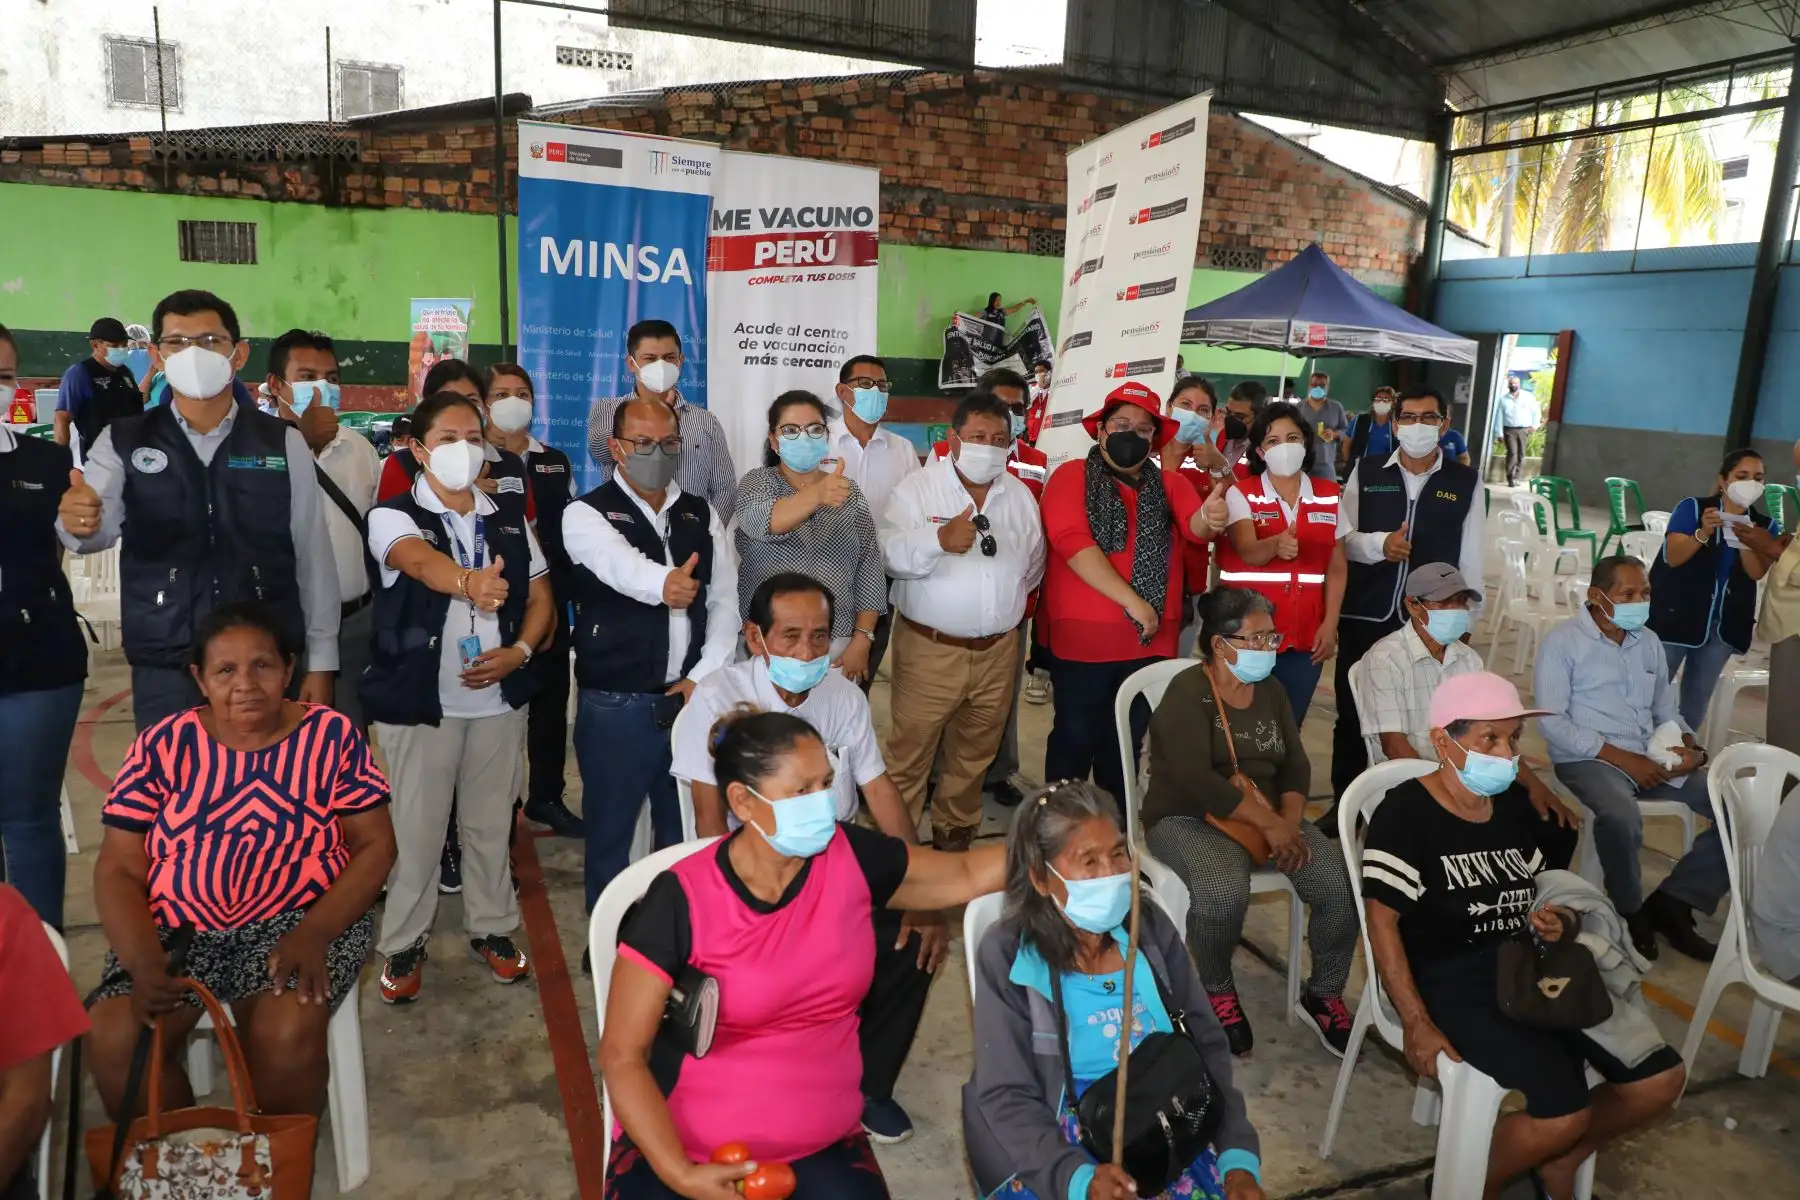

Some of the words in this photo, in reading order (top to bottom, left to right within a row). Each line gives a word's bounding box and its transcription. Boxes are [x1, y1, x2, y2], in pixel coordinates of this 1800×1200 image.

[672, 156, 711, 169] Siempre
[685, 168, 711, 177] pueblo
[713, 209, 751, 231] ME
[759, 206, 874, 229] VACUNO
[754, 232, 837, 266] PERÚ
[540, 236, 693, 285] MINSA
[747, 274, 804, 286] COMPLETA
[806, 273, 826, 282] TUS
[827, 272, 856, 281] DOSIS
[523, 324, 571, 336] Ministerio
[573, 327, 586, 337] de
[587, 328, 613, 339] Salud
[734, 322, 783, 335] Acude
[787, 324, 801, 336] al
[804, 326, 849, 340] centro
[738, 337, 758, 350] de
[763, 338, 845, 355] vacunación
[744, 354, 778, 366] más
[782, 355, 841, 369] cercano
[572, 372, 584, 382] de
[586, 371, 612, 384] Salud
[682, 378, 706, 388] Salud
[532, 417, 569, 426] inisterio
[571, 418, 583, 427] de
[1436, 490, 1457, 502] DAIS
[1440, 851, 1499, 890] NEW
